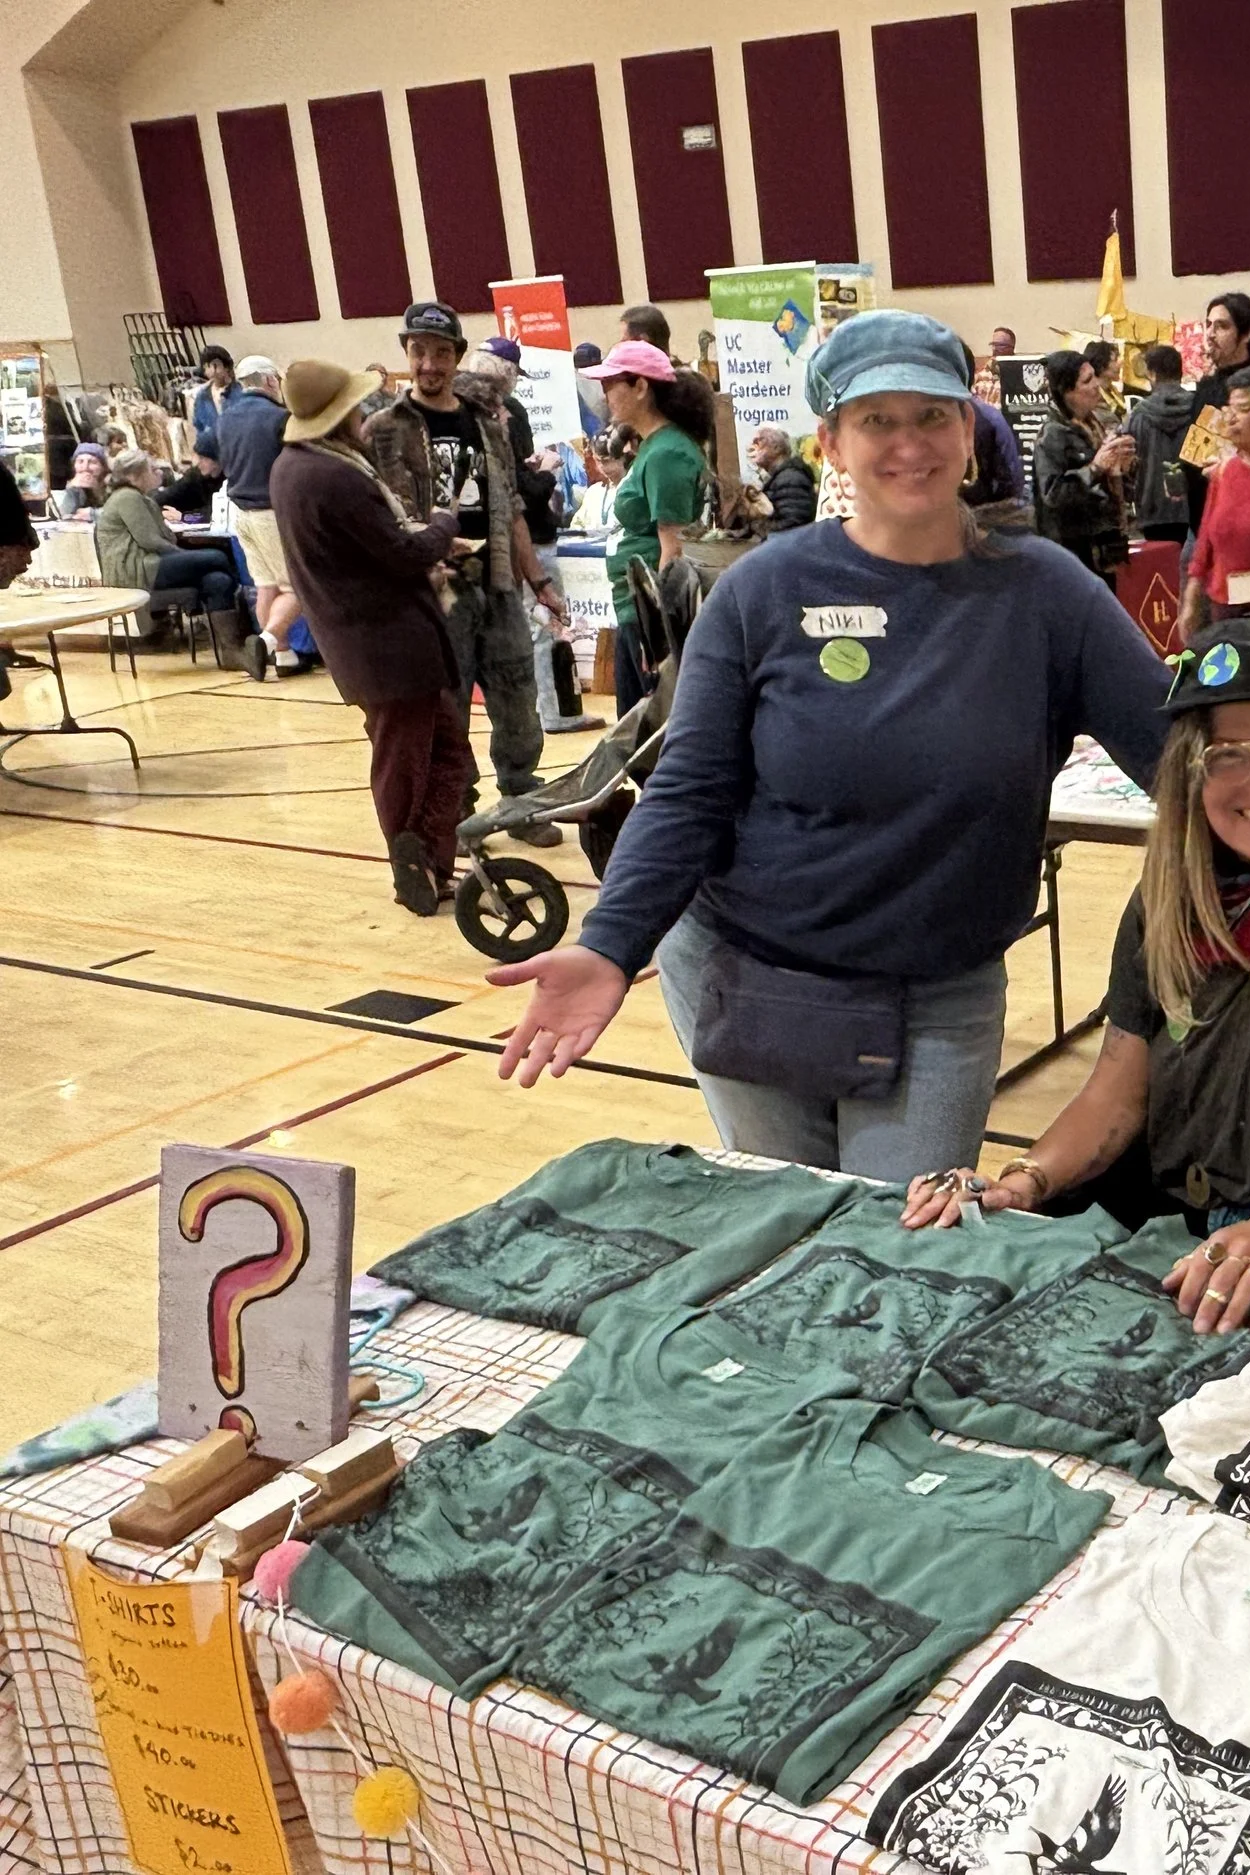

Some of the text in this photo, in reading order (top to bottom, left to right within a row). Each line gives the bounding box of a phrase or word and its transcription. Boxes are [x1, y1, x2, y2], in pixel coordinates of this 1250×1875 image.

[725, 333, 742, 351] UC
[727, 358, 772, 374] Master
[729, 381, 791, 399] Gardener
[732, 406, 789, 426] Program
[178, 1165, 310, 1449] ?
[88, 1577, 176, 1627] T-SHIRTS
[143, 1783, 241, 1835] STICKERS
